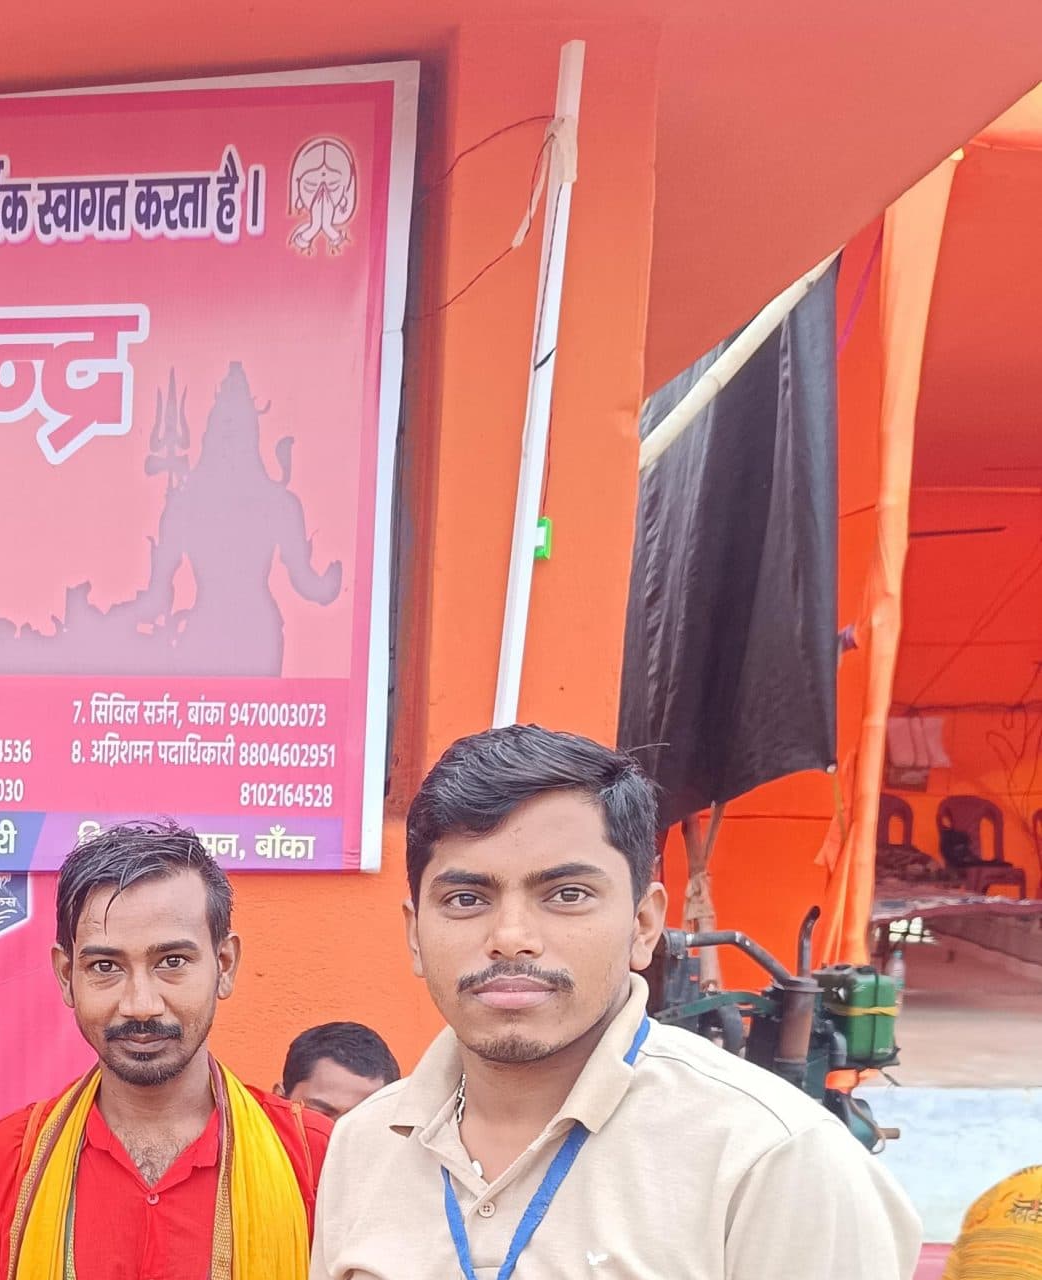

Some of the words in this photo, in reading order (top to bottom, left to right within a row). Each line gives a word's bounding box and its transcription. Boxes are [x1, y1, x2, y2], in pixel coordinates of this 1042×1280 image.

[38, 178, 127, 237] स्वागत
[135, 175, 211, 233] करता
[72, 700, 86, 725] 7.
[90, 692, 140, 726] सिविल
[143, 692, 183, 730] सर्जन,
[187, 694, 226, 727] बांका
[229, 703, 327, 728] 9470003073
[71, 739, 86, 765] 8.
[157, 733, 235, 767] पदाधिकारी
[238, 742, 336, 768] 8804602951
[239, 782, 333, 808] 8102164528
[255, 823, 317, 861] बाँका
